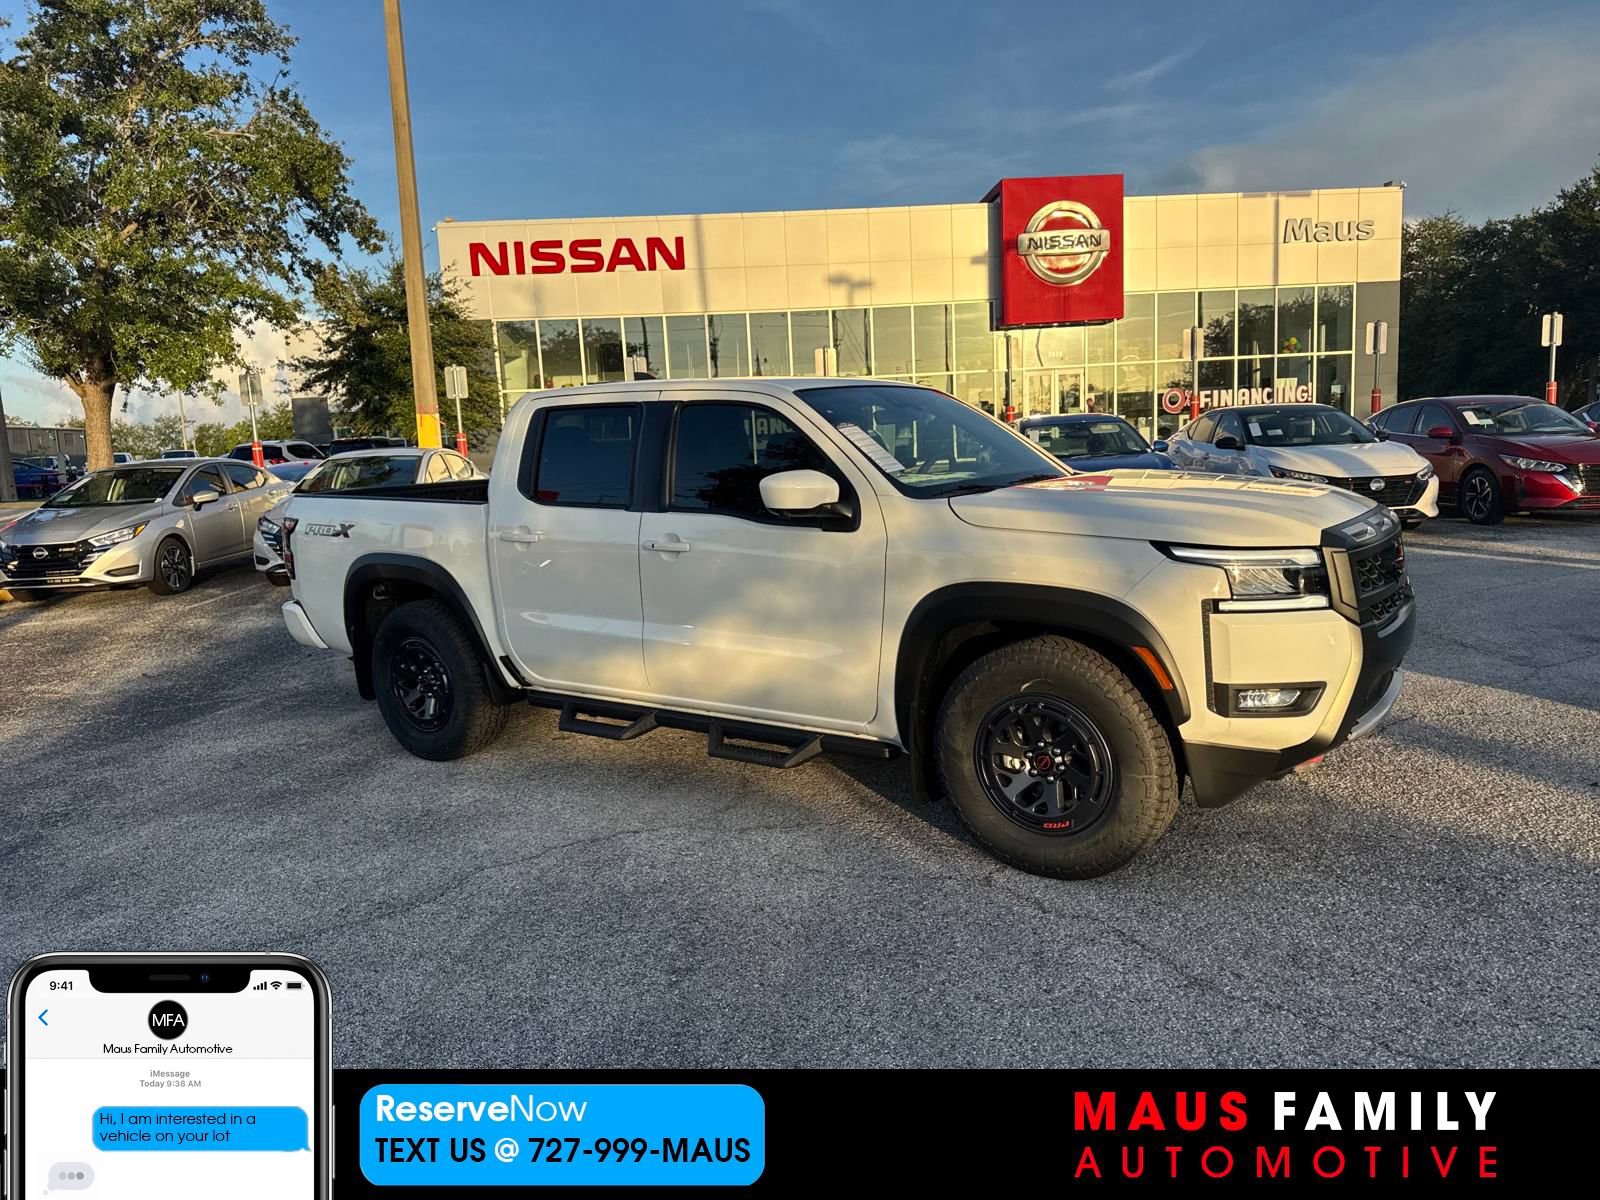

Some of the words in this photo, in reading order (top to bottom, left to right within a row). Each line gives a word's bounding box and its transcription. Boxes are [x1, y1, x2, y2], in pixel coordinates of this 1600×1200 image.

[1027, 234, 1102, 251] NISSAN
[1283, 218, 1375, 243] Maus
[470, 237, 685, 276] NISSAN
[1200, 382, 1313, 408] FINANCING!
